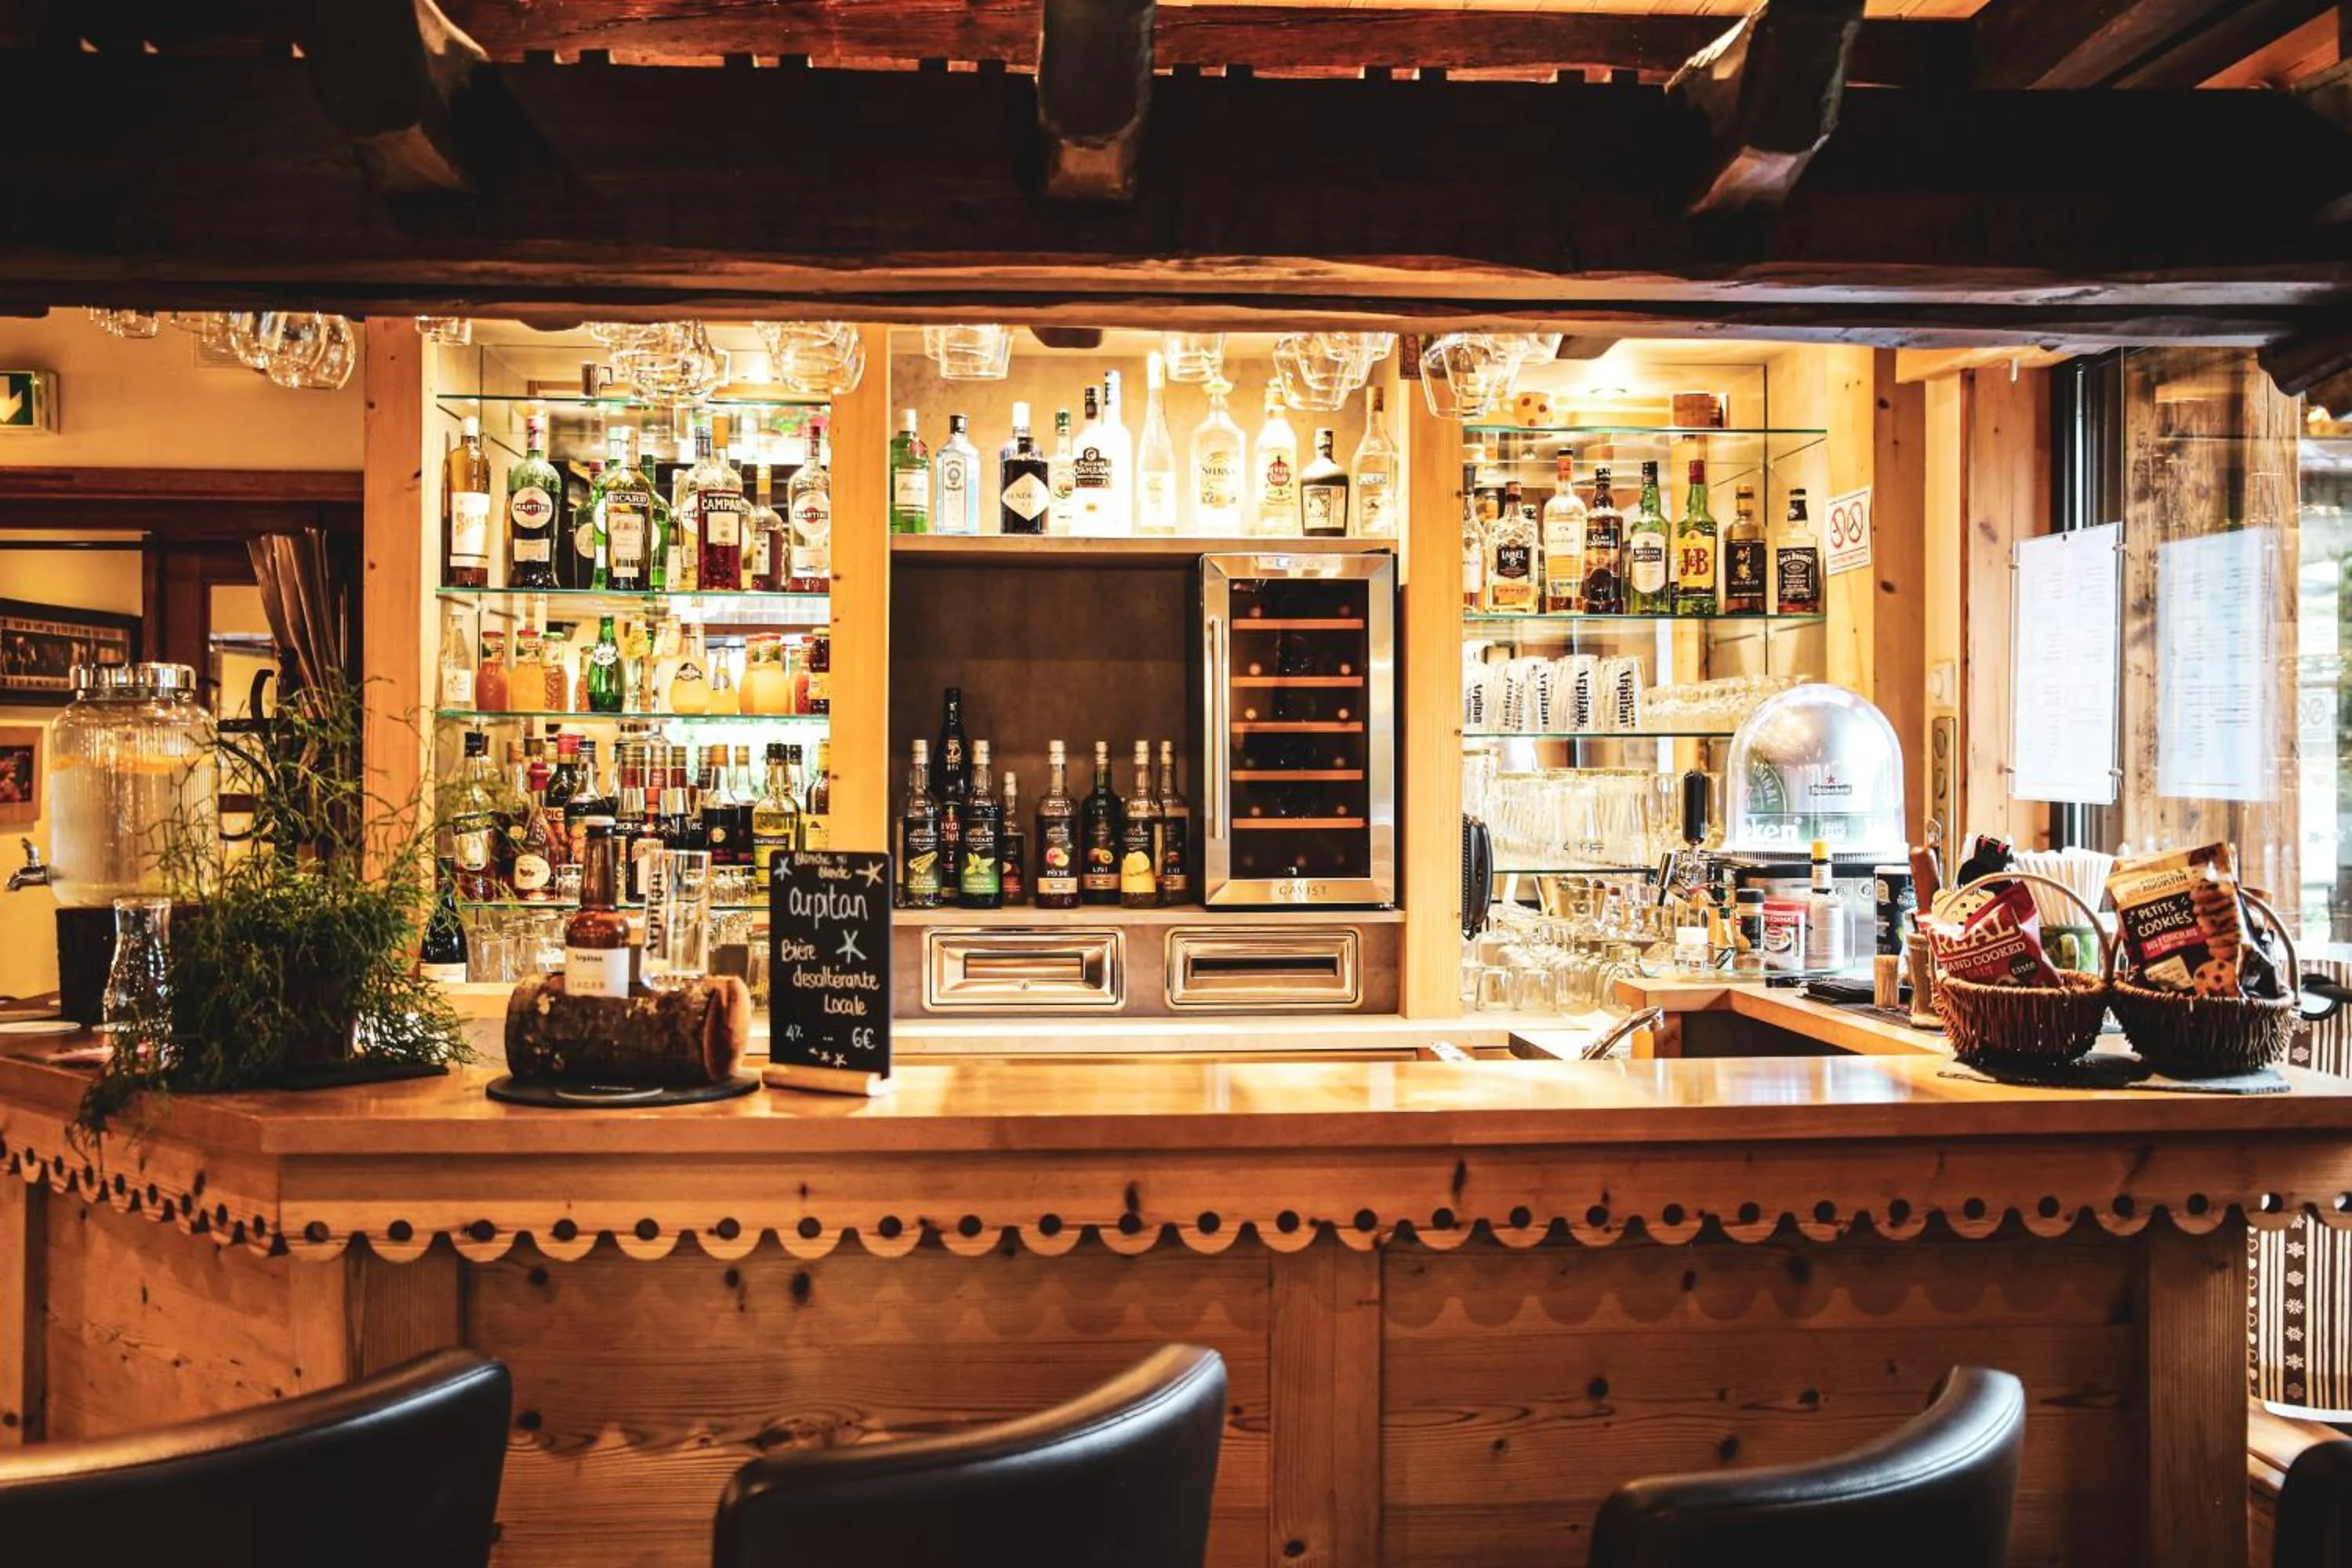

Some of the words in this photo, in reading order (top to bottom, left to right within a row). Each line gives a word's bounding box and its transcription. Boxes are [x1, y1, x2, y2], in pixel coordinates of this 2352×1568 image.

[608, 493, 648, 503] RICARD
[514, 503, 550, 513] MARTINI
[794, 510, 829, 520] MARTINI
[1501, 550, 1524, 561] LABEL
[1809, 786, 1851, 795] Heineken
[546, 808, 564, 820] PIC
[2137, 901, 2176, 920] PETITS
[2137, 910, 2194, 937] COOKIES
[1932, 909, 2016, 955] REAL
[781, 938, 818, 962] Bière
[1972, 941, 2027, 966] COOKED
[2010, 960, 2037, 975] taste
[851, 1025, 875, 1050] 6€
